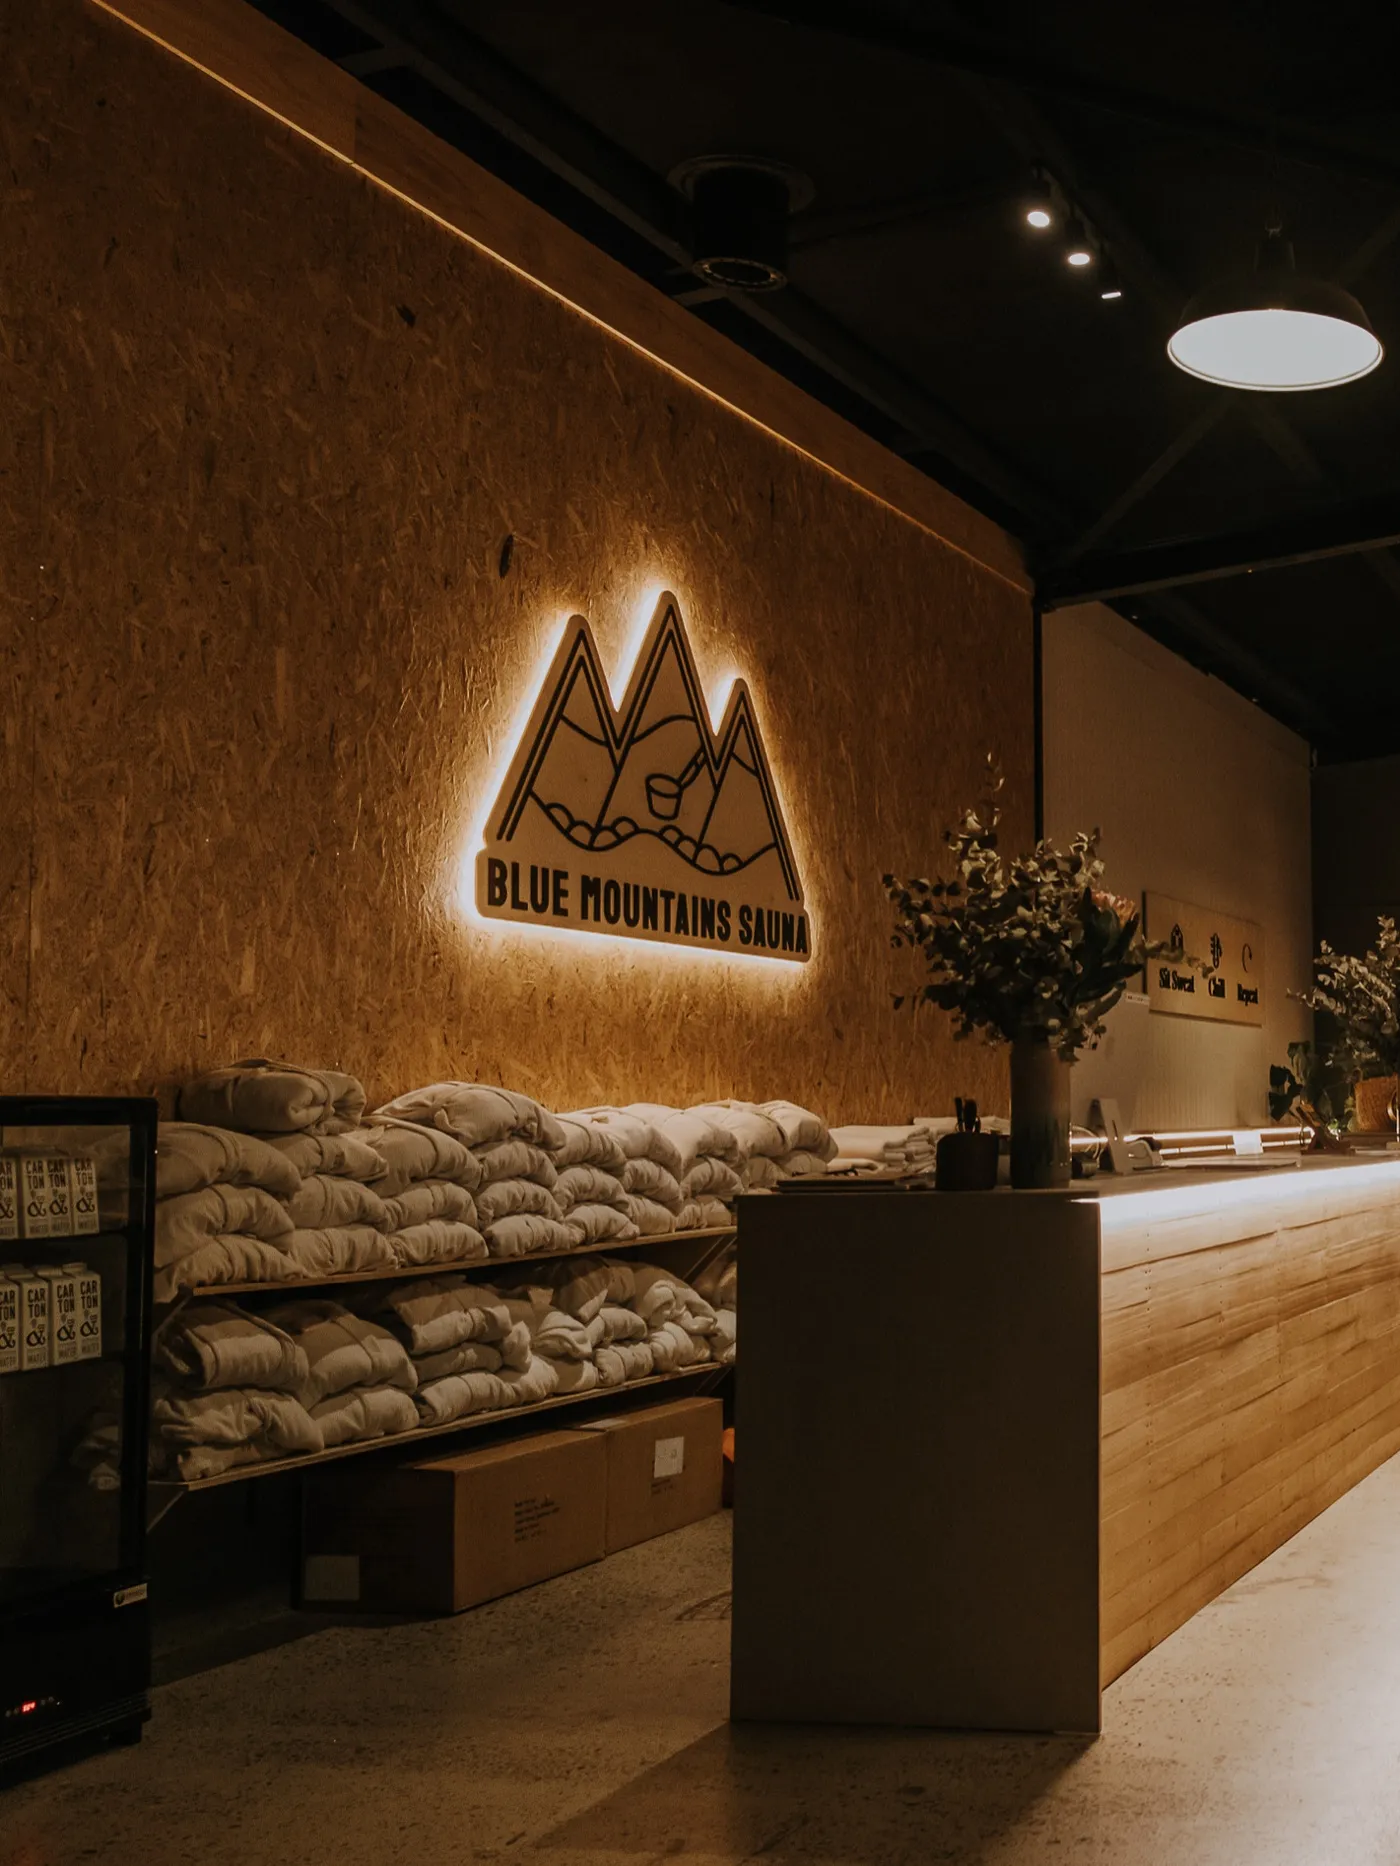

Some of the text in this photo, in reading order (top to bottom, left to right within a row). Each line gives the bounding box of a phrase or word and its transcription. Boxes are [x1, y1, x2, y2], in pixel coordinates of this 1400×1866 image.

[487, 858, 808, 954] BLUE MOUNTAINS SAUNA
[26, 1160, 44, 1174] CAR
[47, 1159, 65, 1173] CAR
[74, 1158, 93, 1171] CAR
[27, 1175, 45, 1189] TON
[48, 1174, 66, 1188] TON
[76, 1172, 94, 1186] TON
[57, 1284, 75, 1299] CAR
[80, 1280, 98, 1295] CAR
[28, 1288, 46, 1303] CAR
[80, 1295, 98, 1309] TON
[28, 1303, 46, 1318] TON
[57, 1299, 75, 1313] TON
